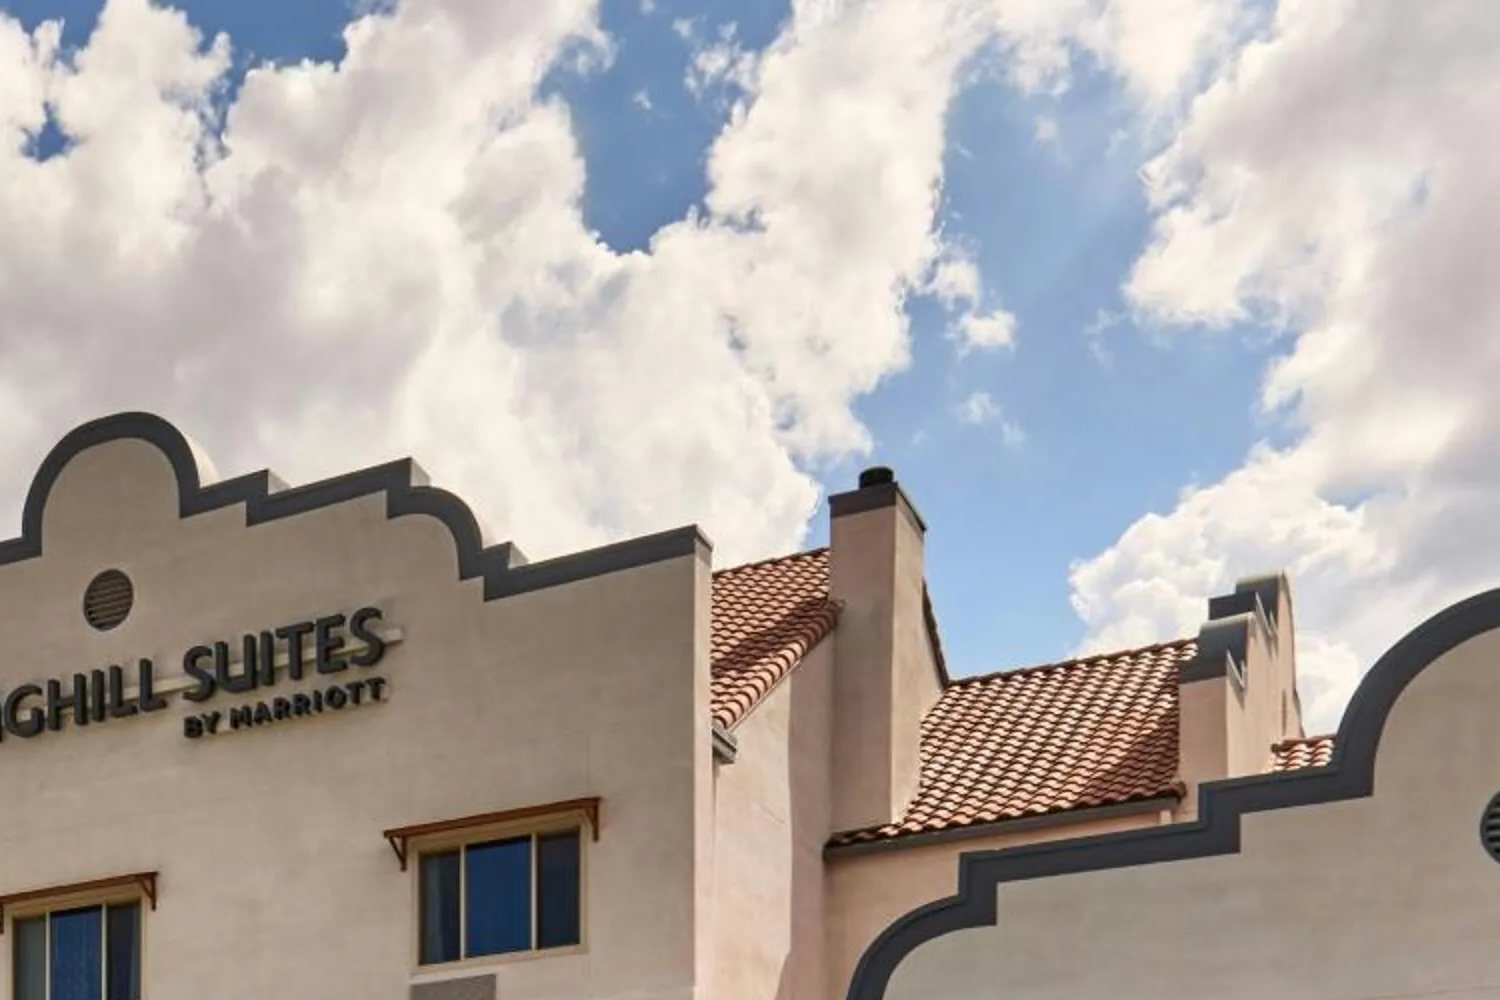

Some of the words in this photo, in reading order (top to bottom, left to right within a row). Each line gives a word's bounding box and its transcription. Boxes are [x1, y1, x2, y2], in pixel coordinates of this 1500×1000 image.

[182, 606, 385, 702] SUITES
[184, 710, 221, 739] BY
[230, 676, 387, 730] MARRIOTT
